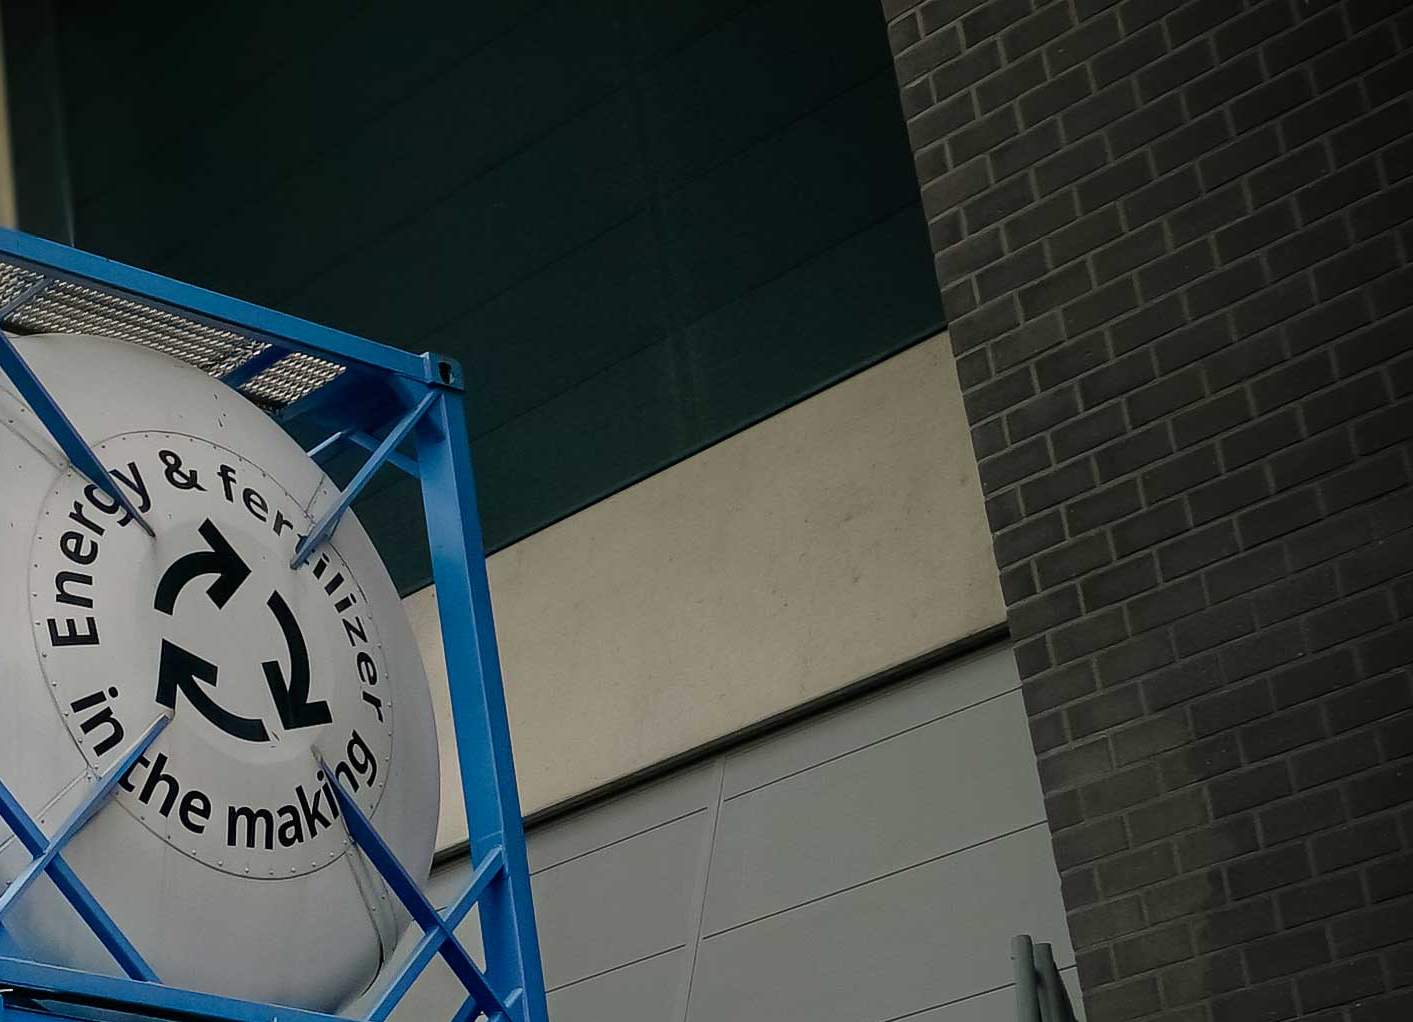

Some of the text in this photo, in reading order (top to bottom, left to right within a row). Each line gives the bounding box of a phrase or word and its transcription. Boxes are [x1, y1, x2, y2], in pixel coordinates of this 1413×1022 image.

[47, 460, 153, 647] Energy
[158, 449, 208, 492] &
[70, 686, 379, 852] in the making
